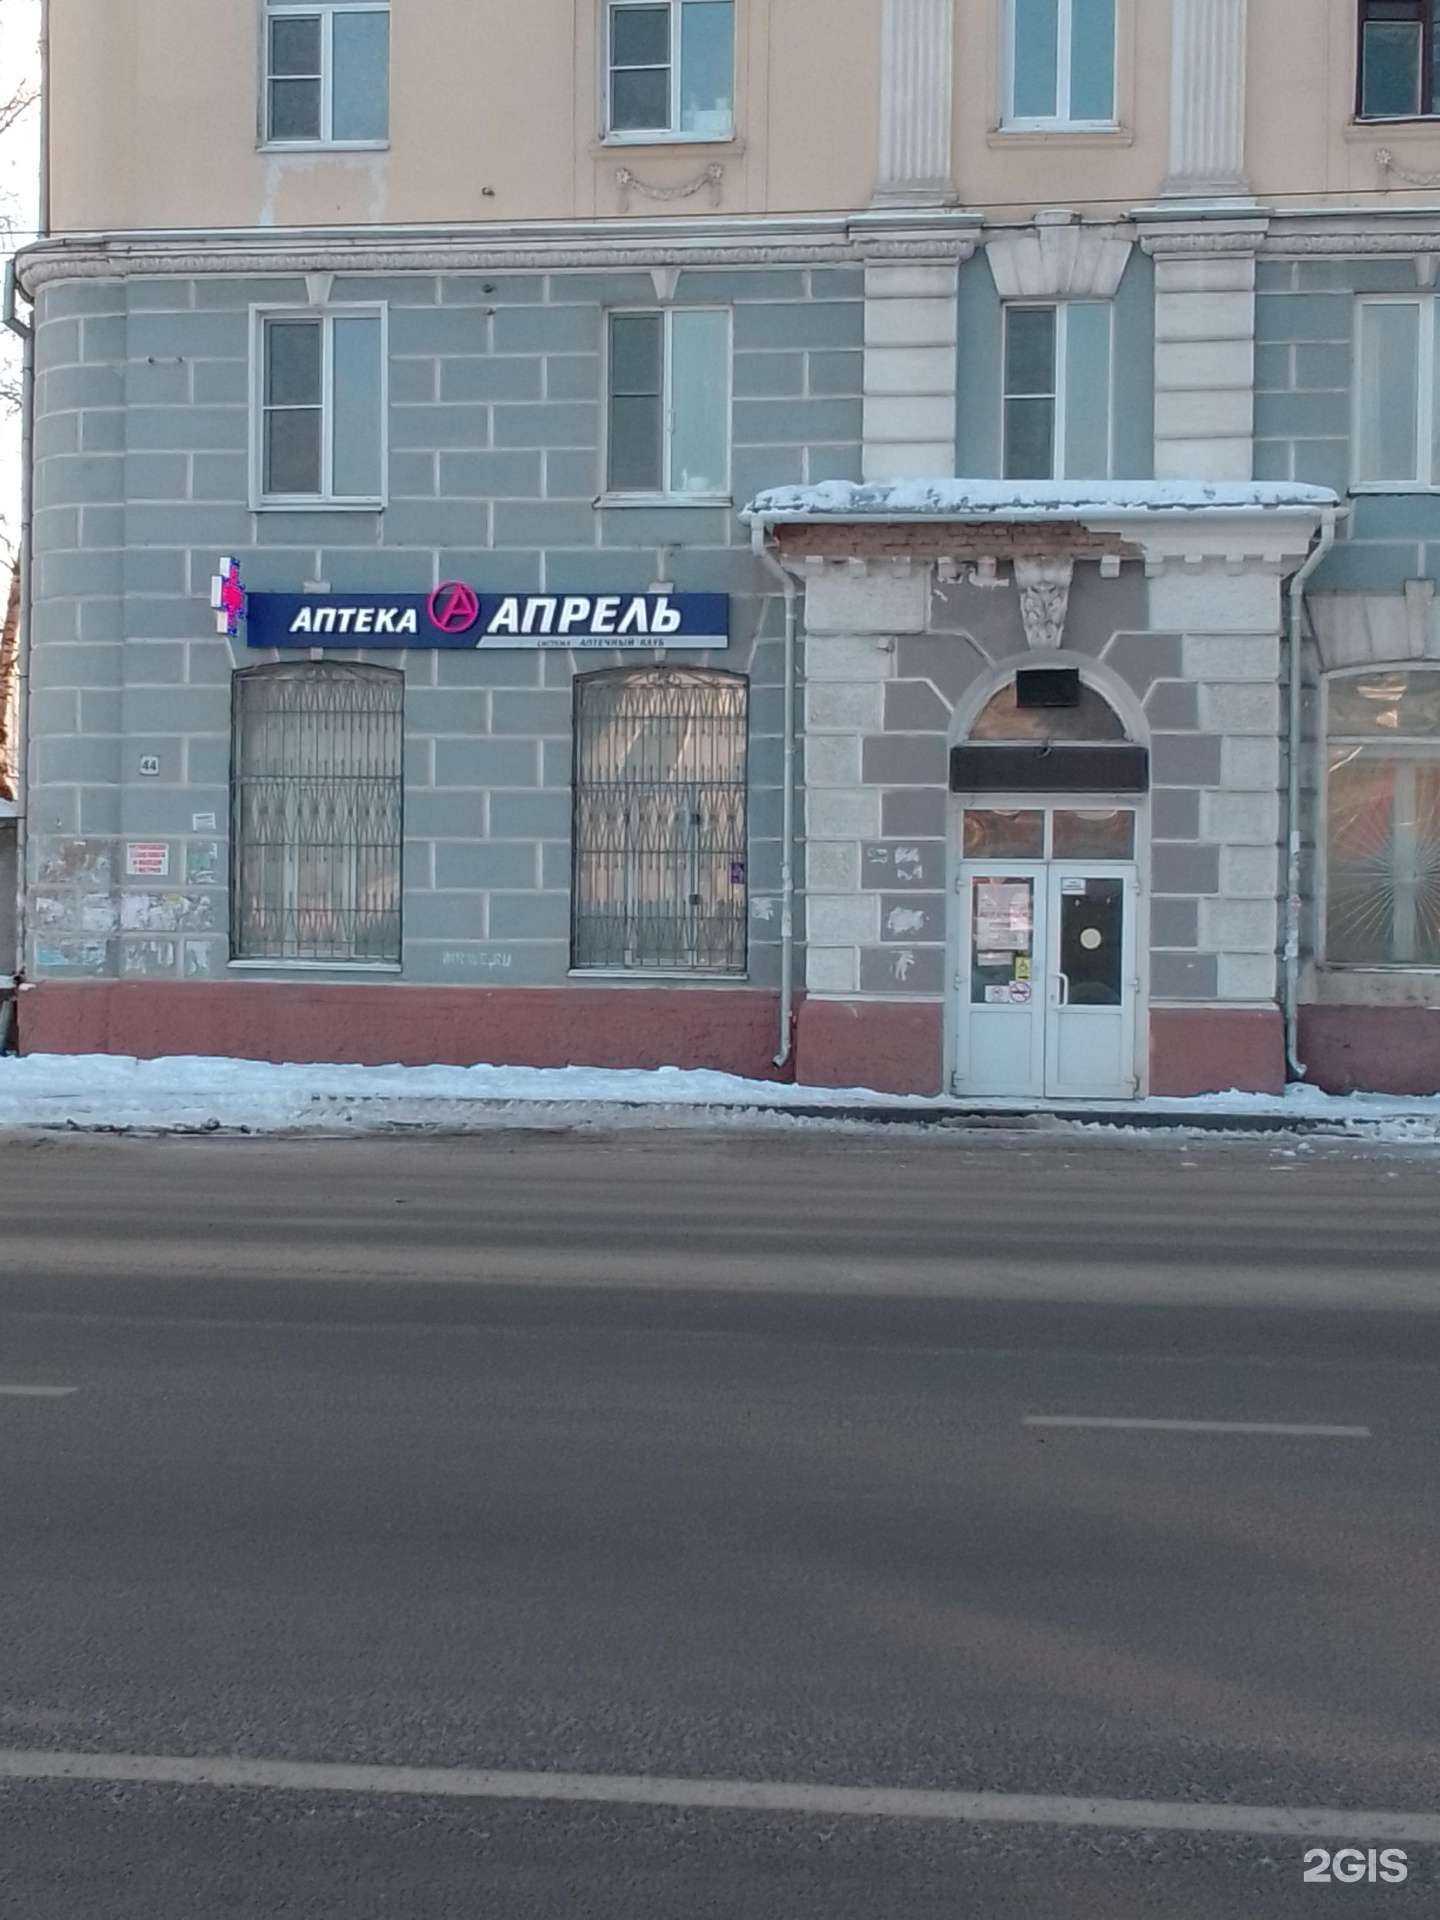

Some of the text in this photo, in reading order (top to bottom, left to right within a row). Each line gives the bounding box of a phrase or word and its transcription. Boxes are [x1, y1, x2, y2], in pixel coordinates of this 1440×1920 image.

[288, 605, 418, 634] АПТЕКА
[486, 596, 682, 634] АПРЕЛЬ
[142, 759, 157, 770] 44
